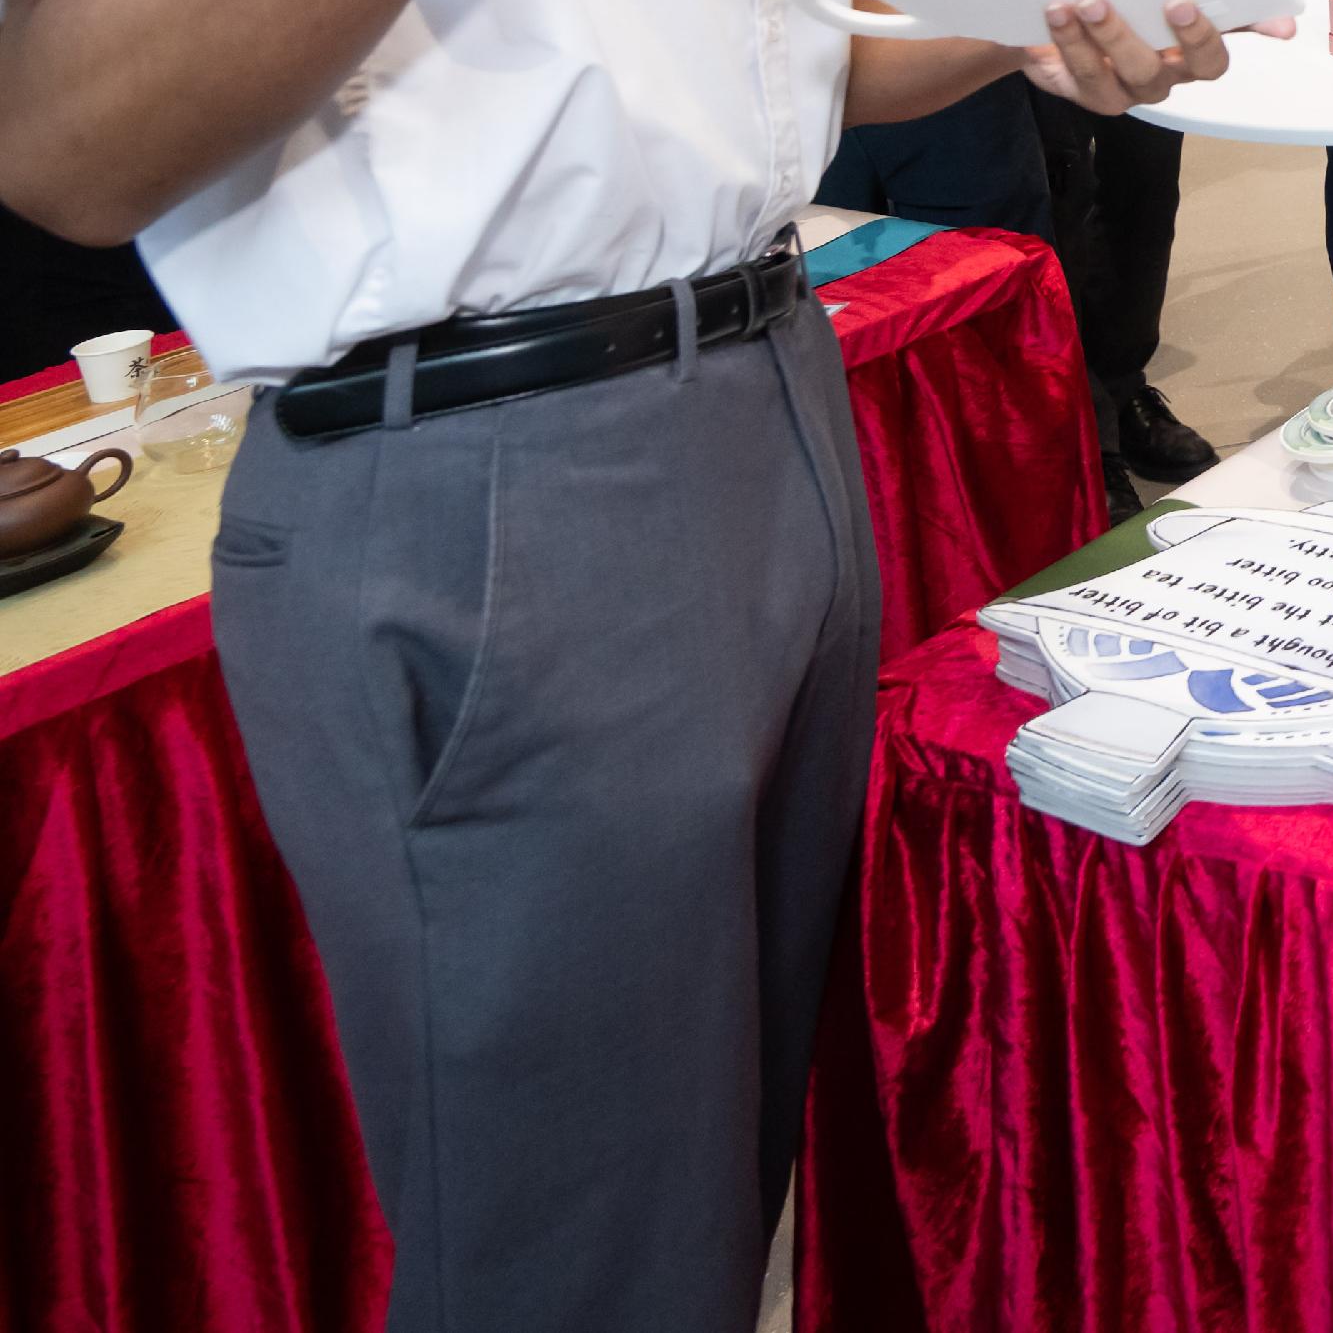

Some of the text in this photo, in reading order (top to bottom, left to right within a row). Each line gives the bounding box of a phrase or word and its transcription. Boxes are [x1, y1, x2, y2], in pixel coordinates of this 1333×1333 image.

[1142, 570, 1183, 587] tea
[1226, 559, 1300, 585] bitter
[1068, 588, 1144, 616] bitter
[1188, 583, 1264, 610] bitter
[1141, 608, 1179, 621] of
[1271, 602, 1311, 620] the
[1183, 617, 1224, 637] bit
[1230, 628, 1250, 637] a
